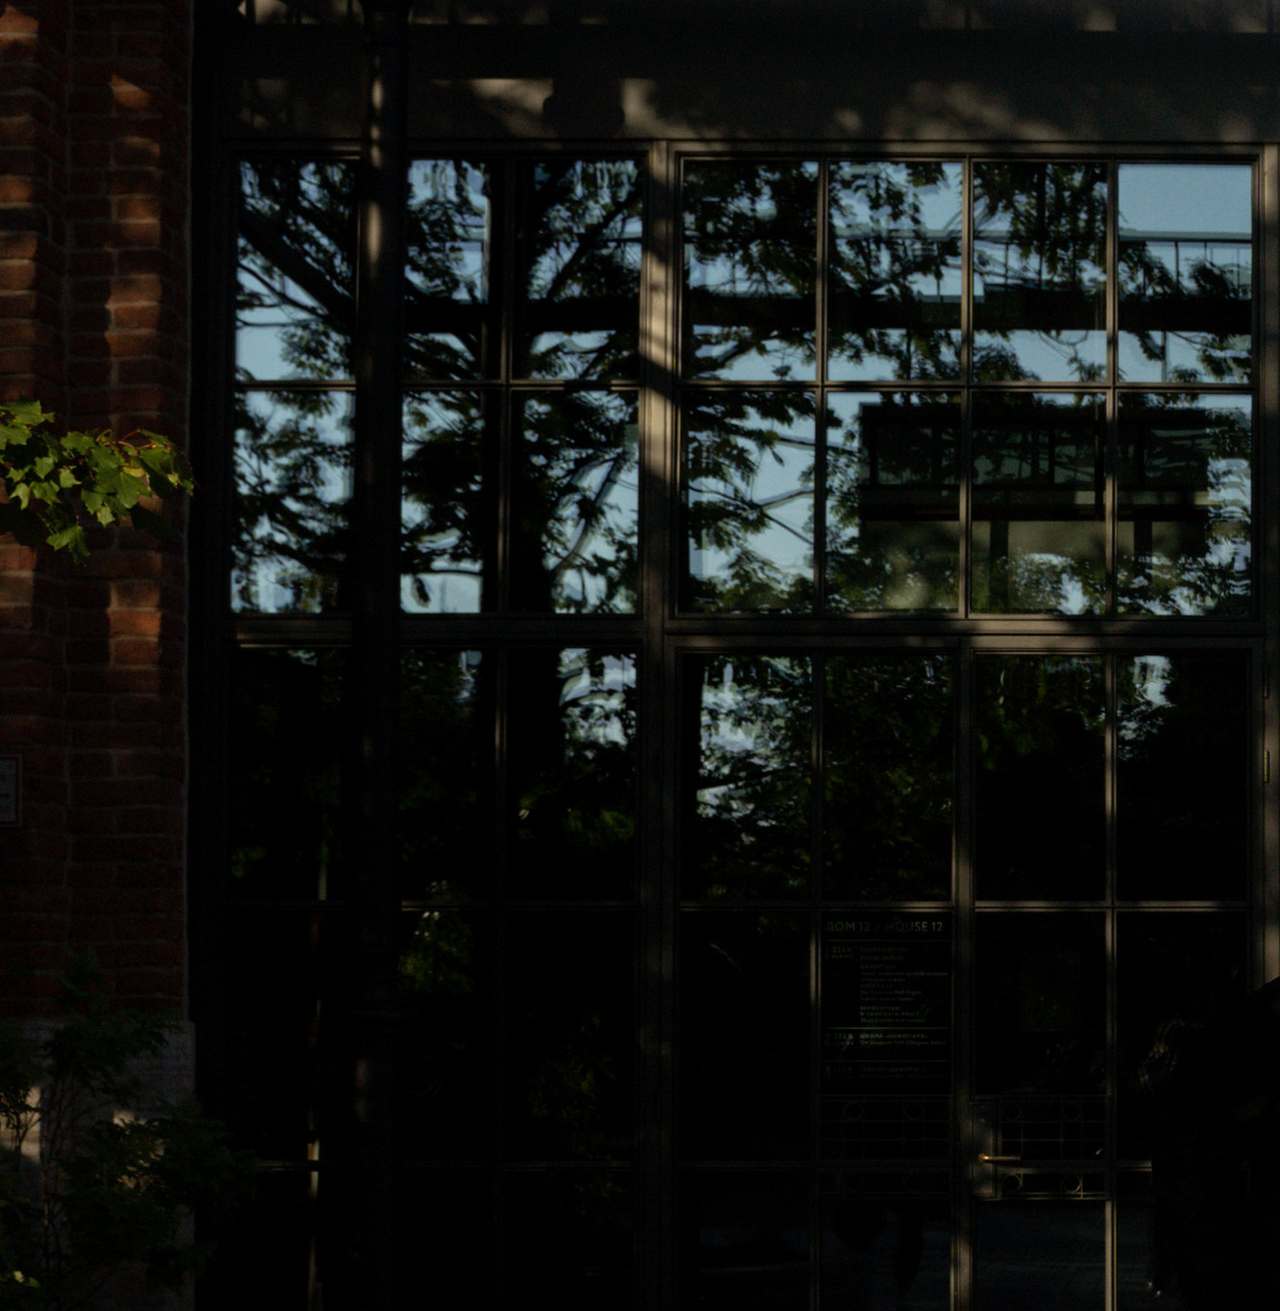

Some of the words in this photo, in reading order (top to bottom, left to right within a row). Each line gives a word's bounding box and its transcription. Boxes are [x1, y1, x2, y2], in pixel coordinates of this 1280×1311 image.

[825, 921, 856, 932] ДОМ
[859, 921, 871, 932] 12
[885, 921, 929, 932] HOUSE
[931, 921, 944, 932] 12
